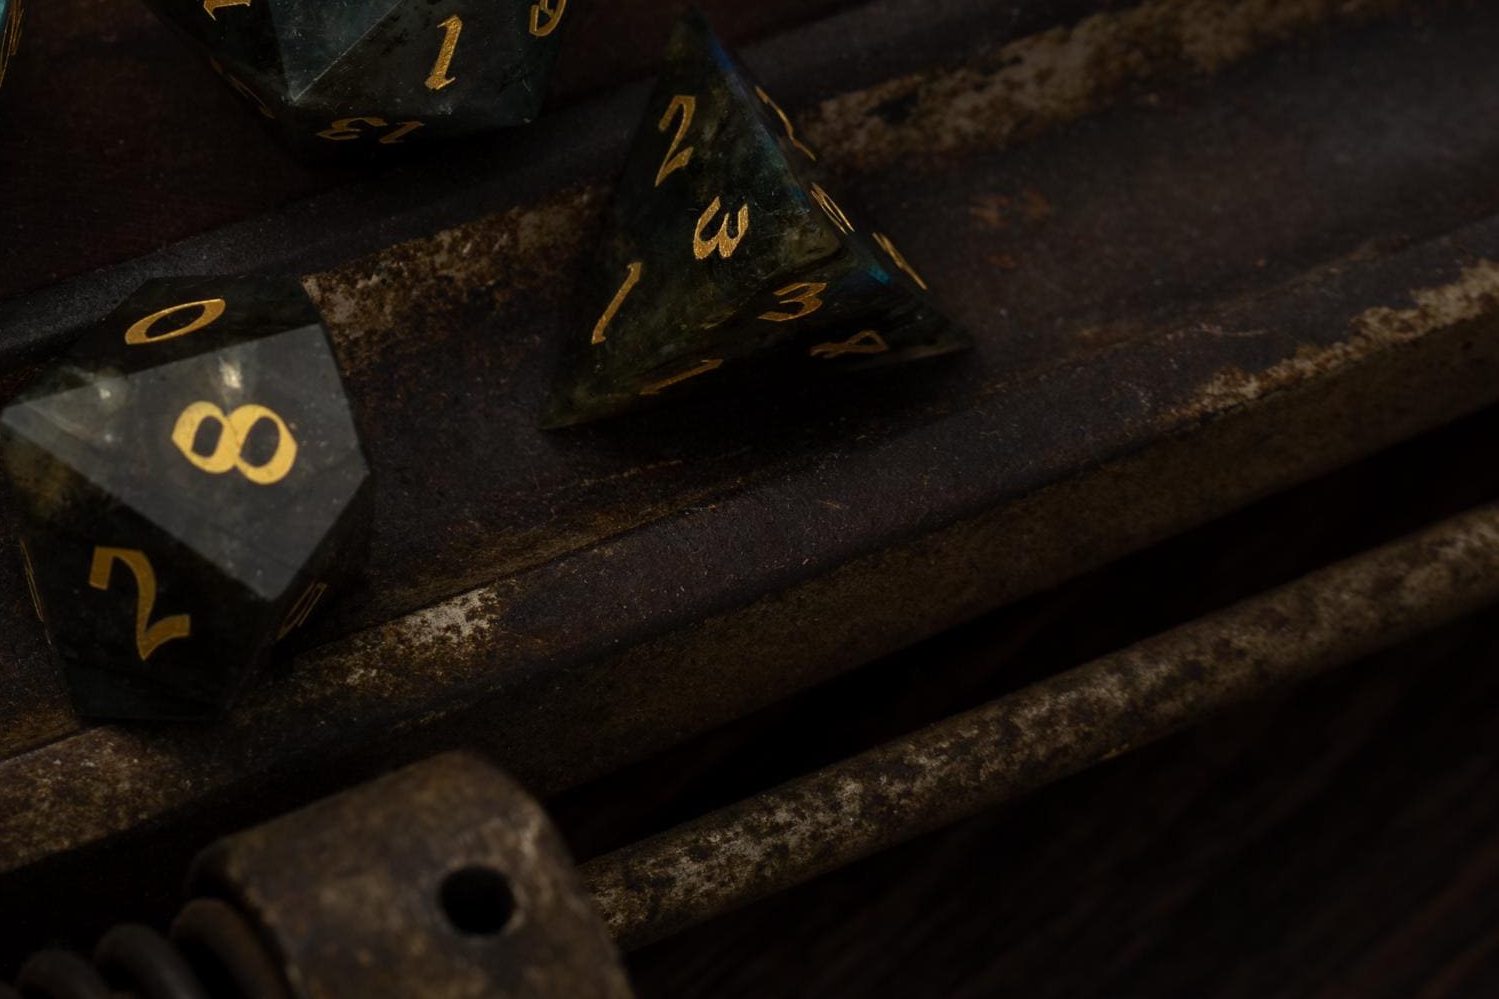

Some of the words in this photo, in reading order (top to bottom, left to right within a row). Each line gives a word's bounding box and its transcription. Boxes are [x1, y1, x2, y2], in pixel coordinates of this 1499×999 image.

[424, 13, 465, 92] 1
[654, 94, 697, 188] 2
[692, 196, 750, 261] 3
[124, 297, 227, 345] 0
[592, 261, 644, 344] 1
[756, 281, 828, 322] 3
[171, 400, 298, 486] 8
[87, 544, 192, 663] 2
